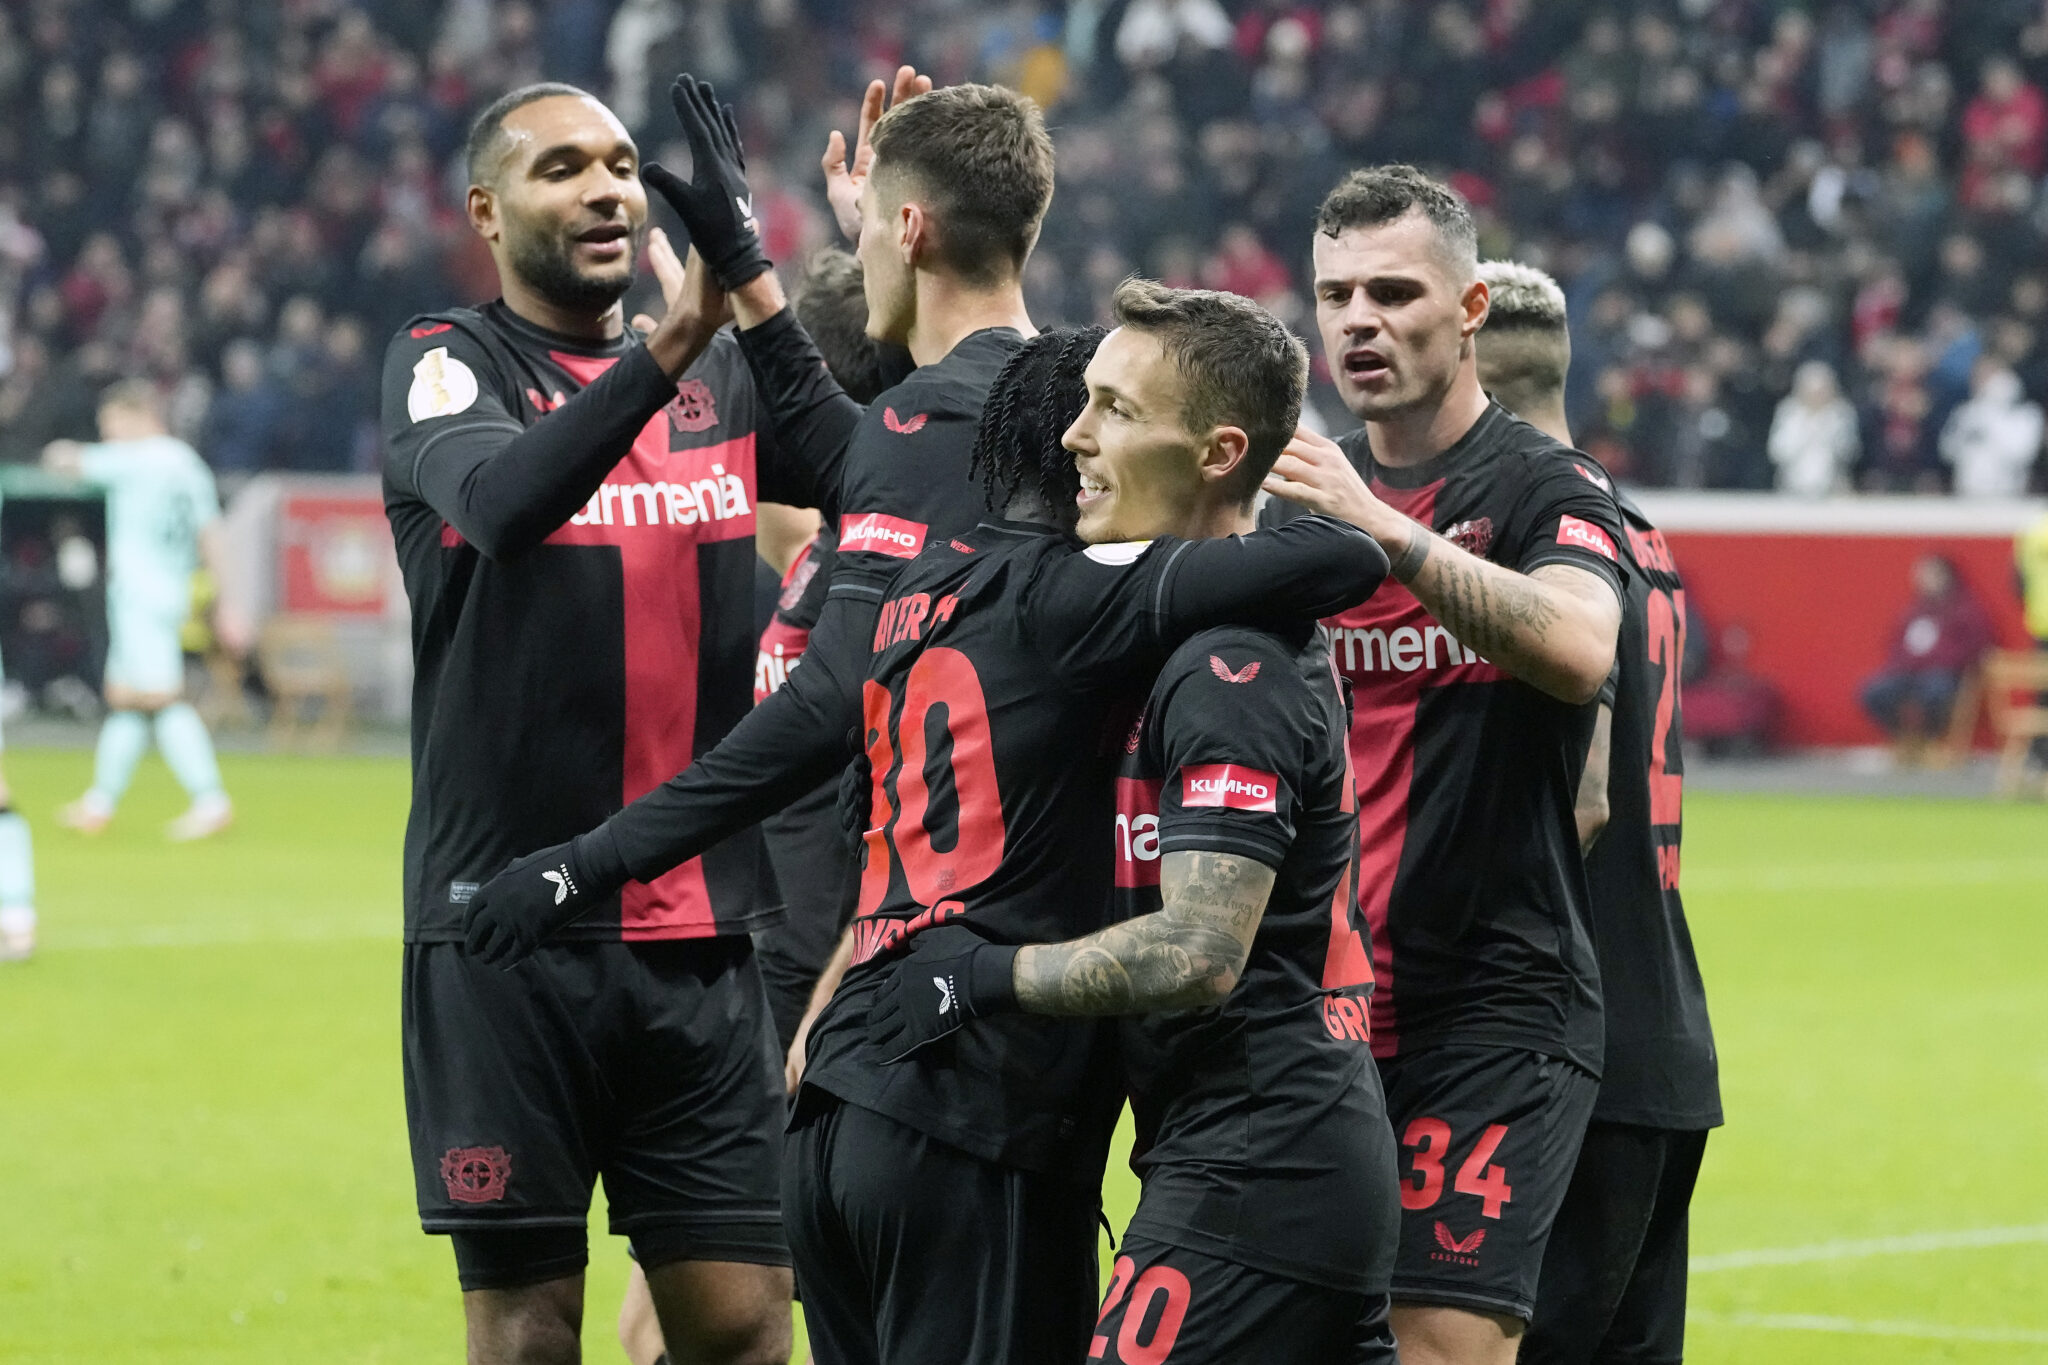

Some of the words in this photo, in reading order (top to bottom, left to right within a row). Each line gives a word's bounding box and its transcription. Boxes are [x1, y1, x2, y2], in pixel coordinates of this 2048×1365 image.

[845, 525, 917, 548] KUMHO
[1566, 527, 1614, 561] KUM
[1190, 779, 1269, 799] KUMHO
[1323, 993, 1372, 1043] GRI
[1400, 1116, 1512, 1220] 34
[1429, 1252, 1480, 1268] CASTORE
[1087, 1254, 1192, 1365] 20
